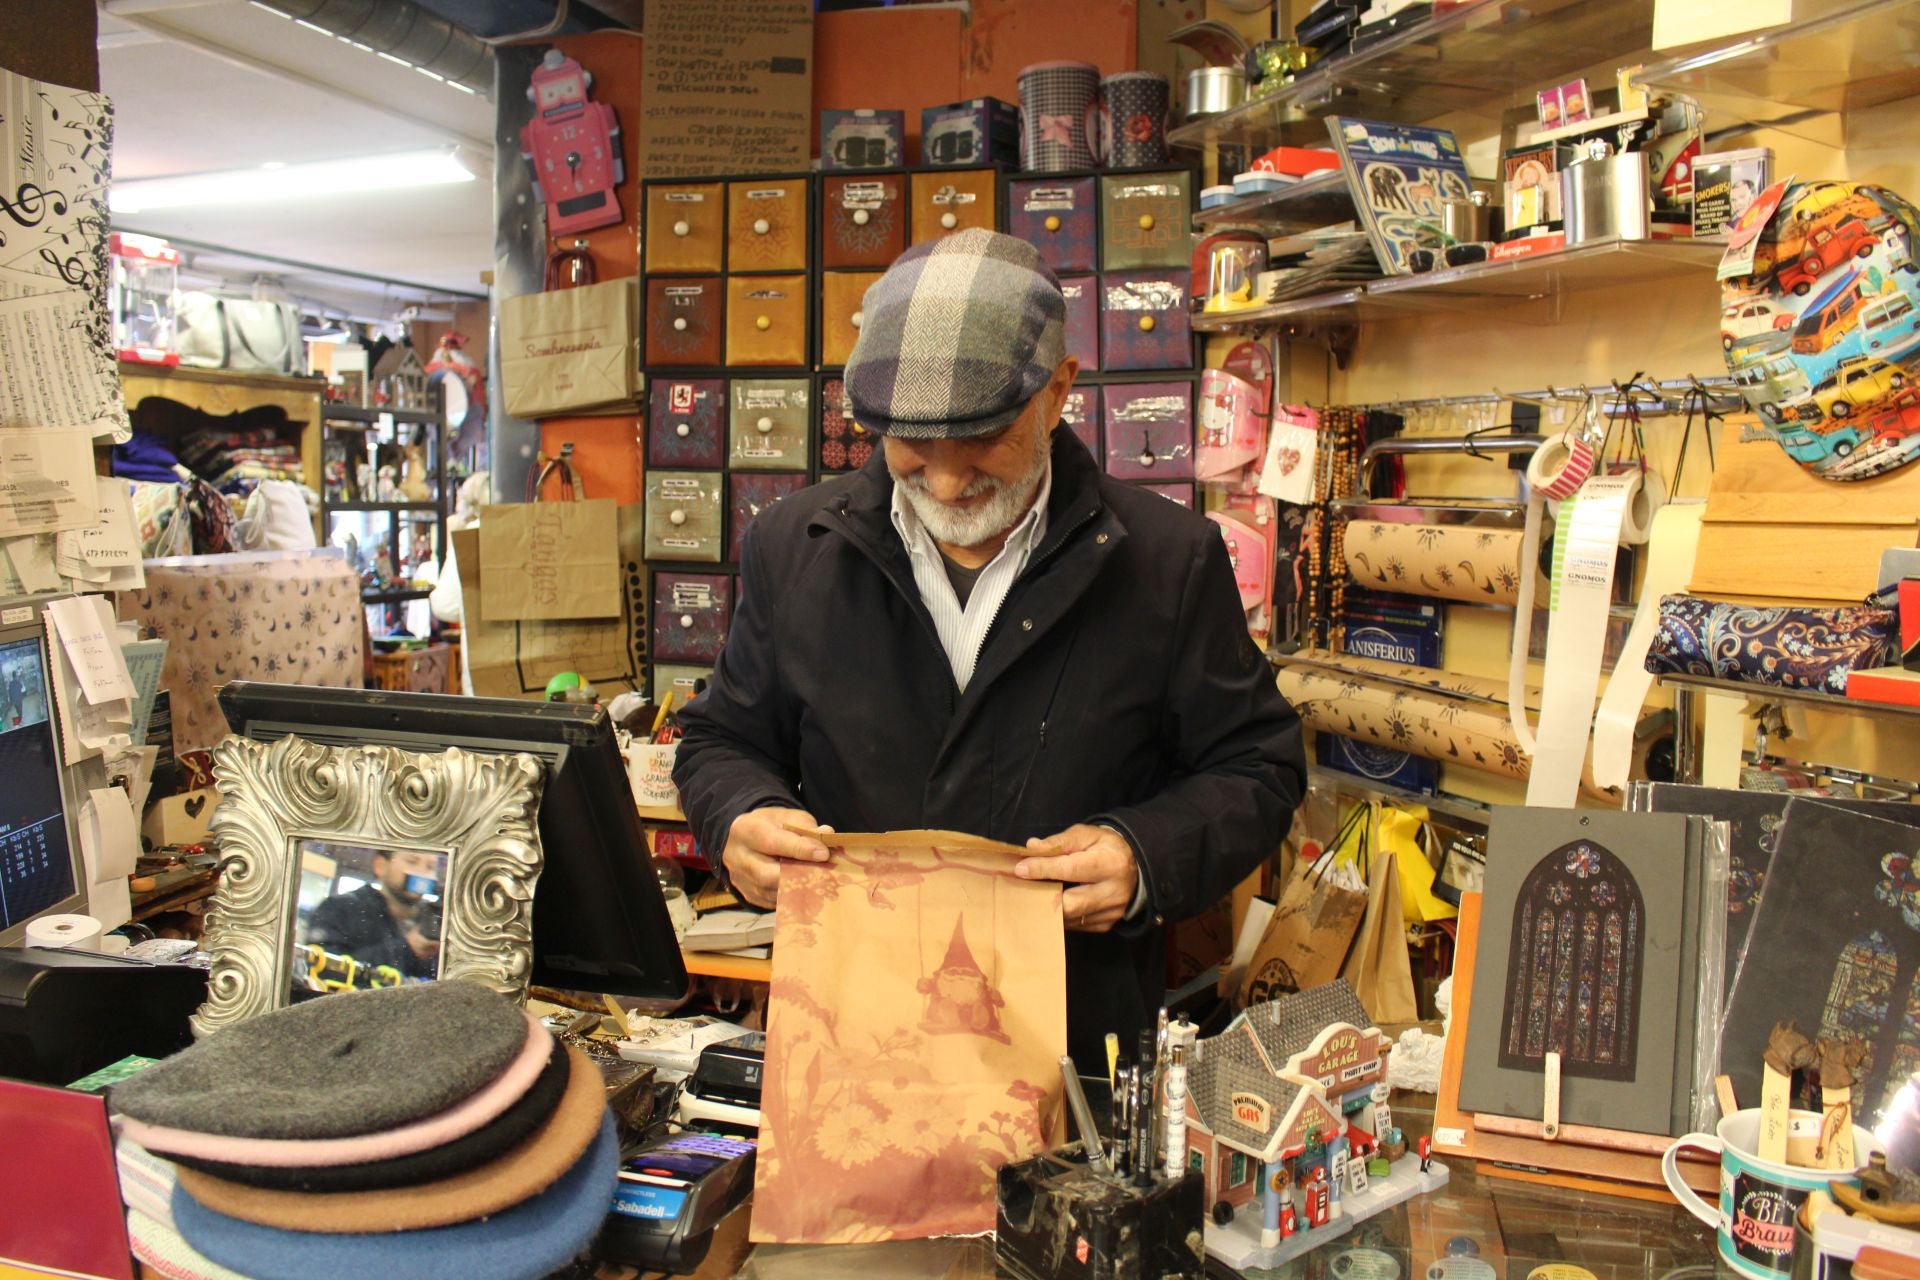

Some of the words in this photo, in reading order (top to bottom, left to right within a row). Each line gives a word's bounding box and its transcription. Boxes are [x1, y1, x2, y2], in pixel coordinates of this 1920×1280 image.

[1567, 572, 1607, 583] GNOMOS
[1345, 639, 1416, 664] ANISFERIUS
[1322, 1034, 1358, 1058] LOU'S
[1318, 1050, 1359, 1074] GARAGE
[1233, 1096, 1264, 1113] PREMIUM
[1238, 1106, 1260, 1123] GAS
[616, 1199, 665, 1217] Sabadell
[1752, 1197, 1784, 1225] BE
[1738, 1218, 1793, 1244] Brav
